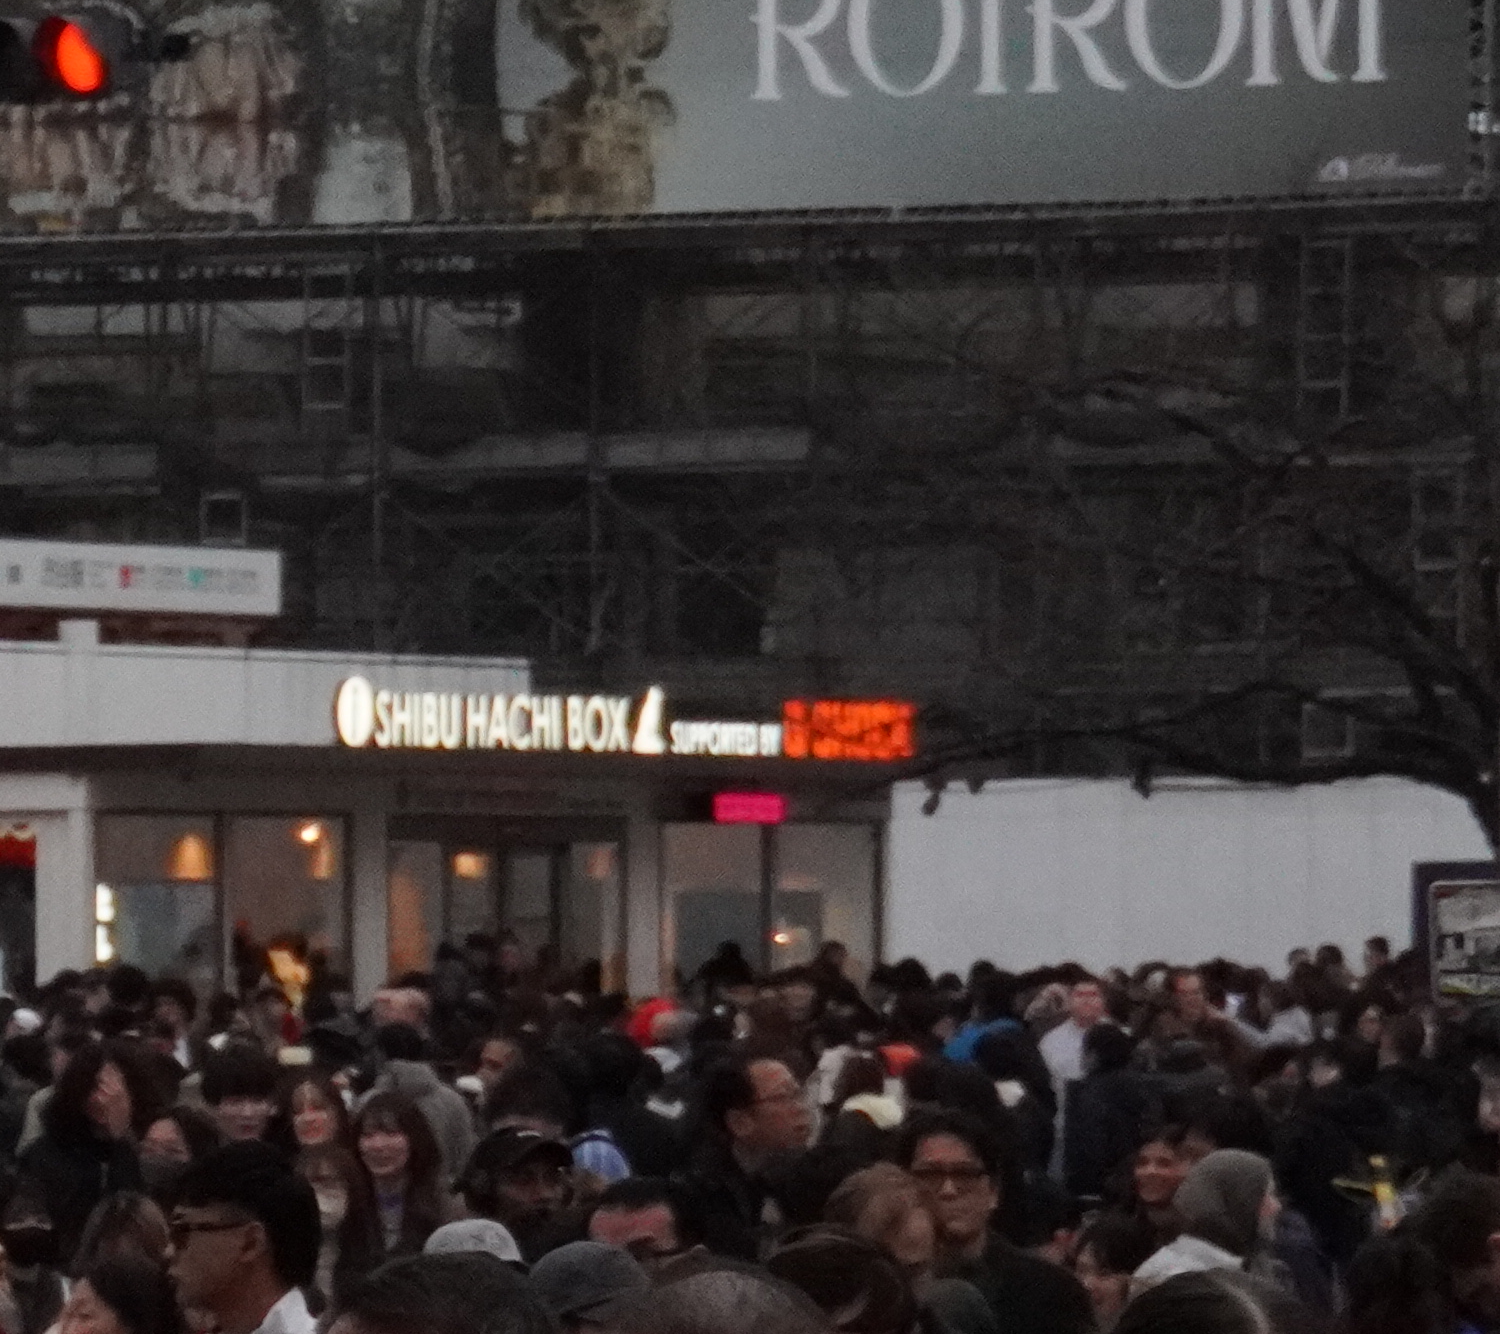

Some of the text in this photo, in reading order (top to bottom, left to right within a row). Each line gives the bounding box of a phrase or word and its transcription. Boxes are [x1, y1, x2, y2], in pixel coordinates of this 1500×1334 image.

[374, 690, 461, 749] SHIBU
[466, 692, 561, 751] HACHI
[566, 696, 633, 753] BOX
